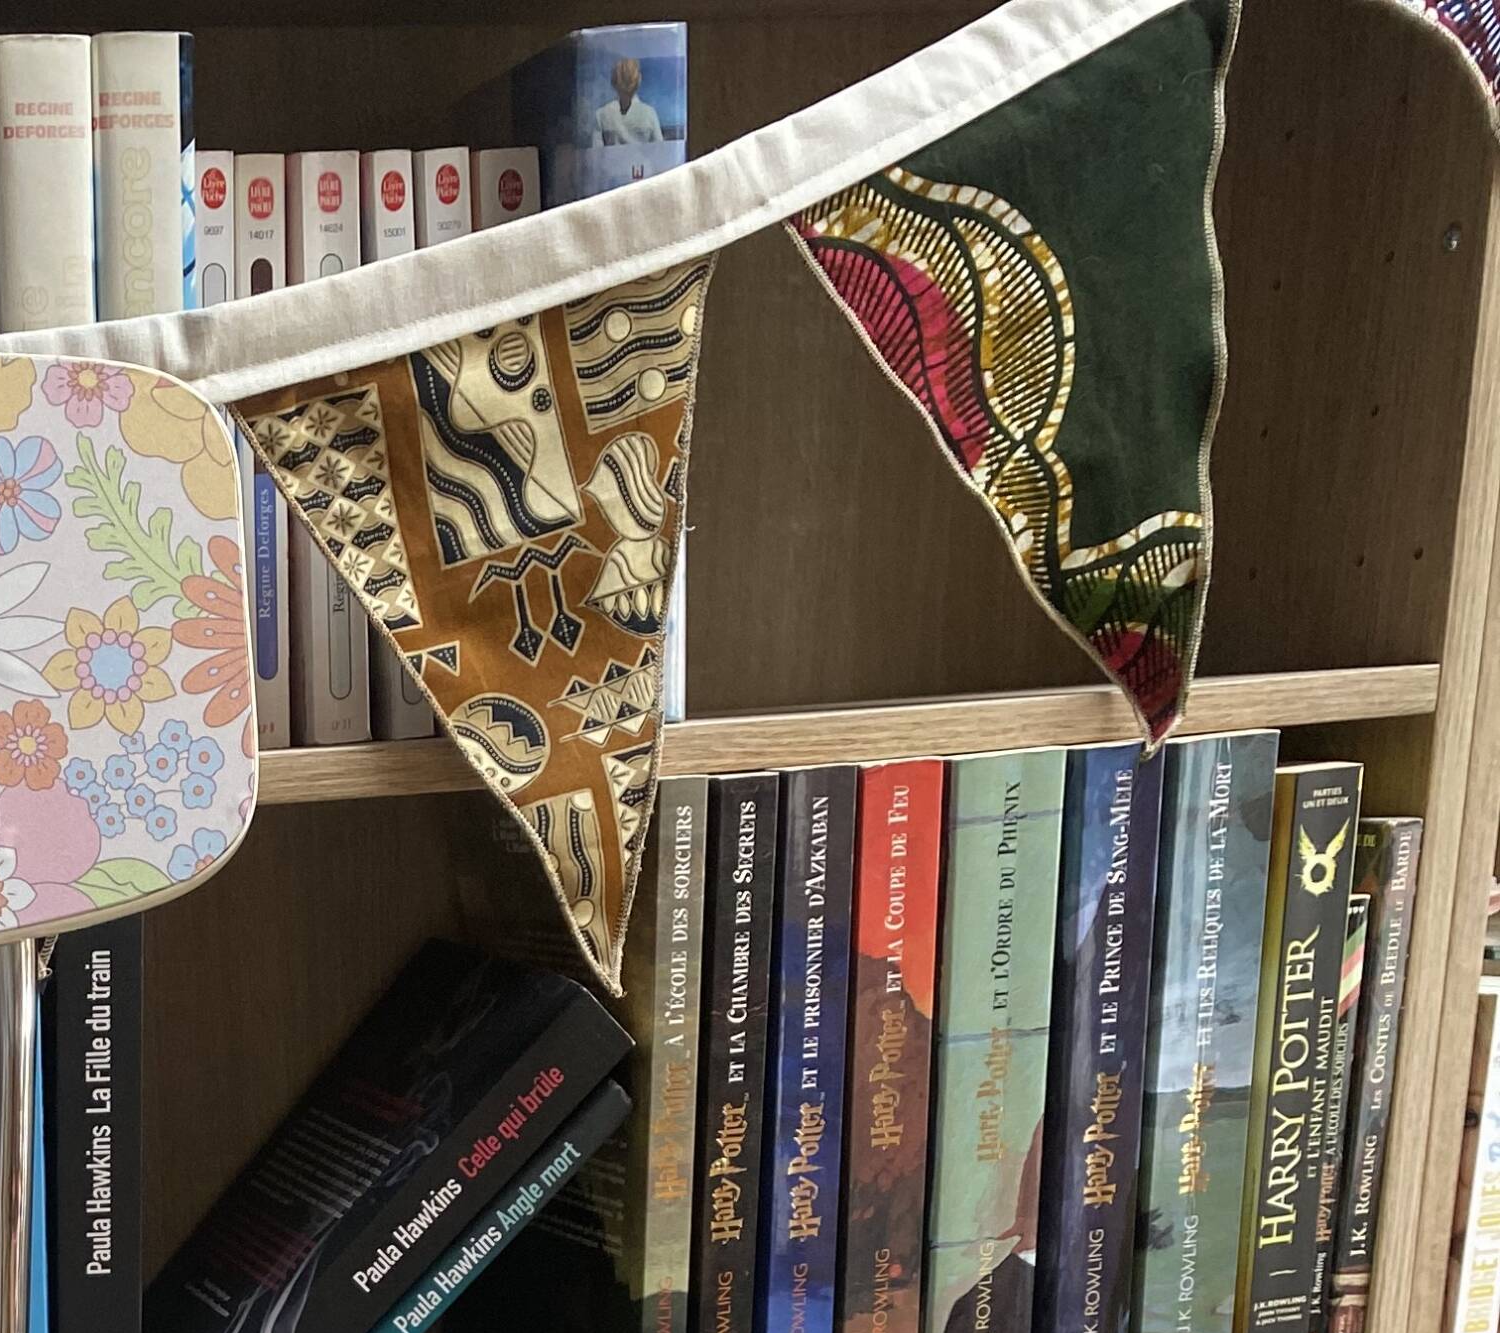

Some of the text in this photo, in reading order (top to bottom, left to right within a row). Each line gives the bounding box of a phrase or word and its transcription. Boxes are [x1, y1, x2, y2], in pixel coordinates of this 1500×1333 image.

[3, 125, 86, 140] DEFORGES
[15, 102, 74, 117] REGINE
[257, 489, 271, 558] Deforges
[674, 806, 693, 899] SORCIERS
[884, 785, 911, 993] ET LA COUPE DE FEU
[1208, 856, 1224, 880] DE
[672, 908, 688, 943] DES
[728, 801, 757, 1083] ET LA DES SECRETS
[992, 866, 1016, 1011] ET DU
[803, 914, 825, 1089] ET LE PRISONNIER
[1099, 891, 1126, 1055] ET LE PRINCE DE
[1315, 995, 1334, 1071] MAUDIT
[85, 949, 113, 1275] Paula Hawkins La Fille du train
[1259, 924, 1320, 1249] HARRY POTTER
[352, 1066, 565, 1293] Paula Hawkins Celle qui brûle
[432, 1225, 503, 1294] Hawkins
[495, 1182, 544, 1232] Angle
[539, 1141, 582, 1189] mort
[975, 1240, 995, 1330] ROWLING
[1083, 1228, 1105, 1316] ROWLING
[1179, 1214, 1200, 1303] ROWLING
